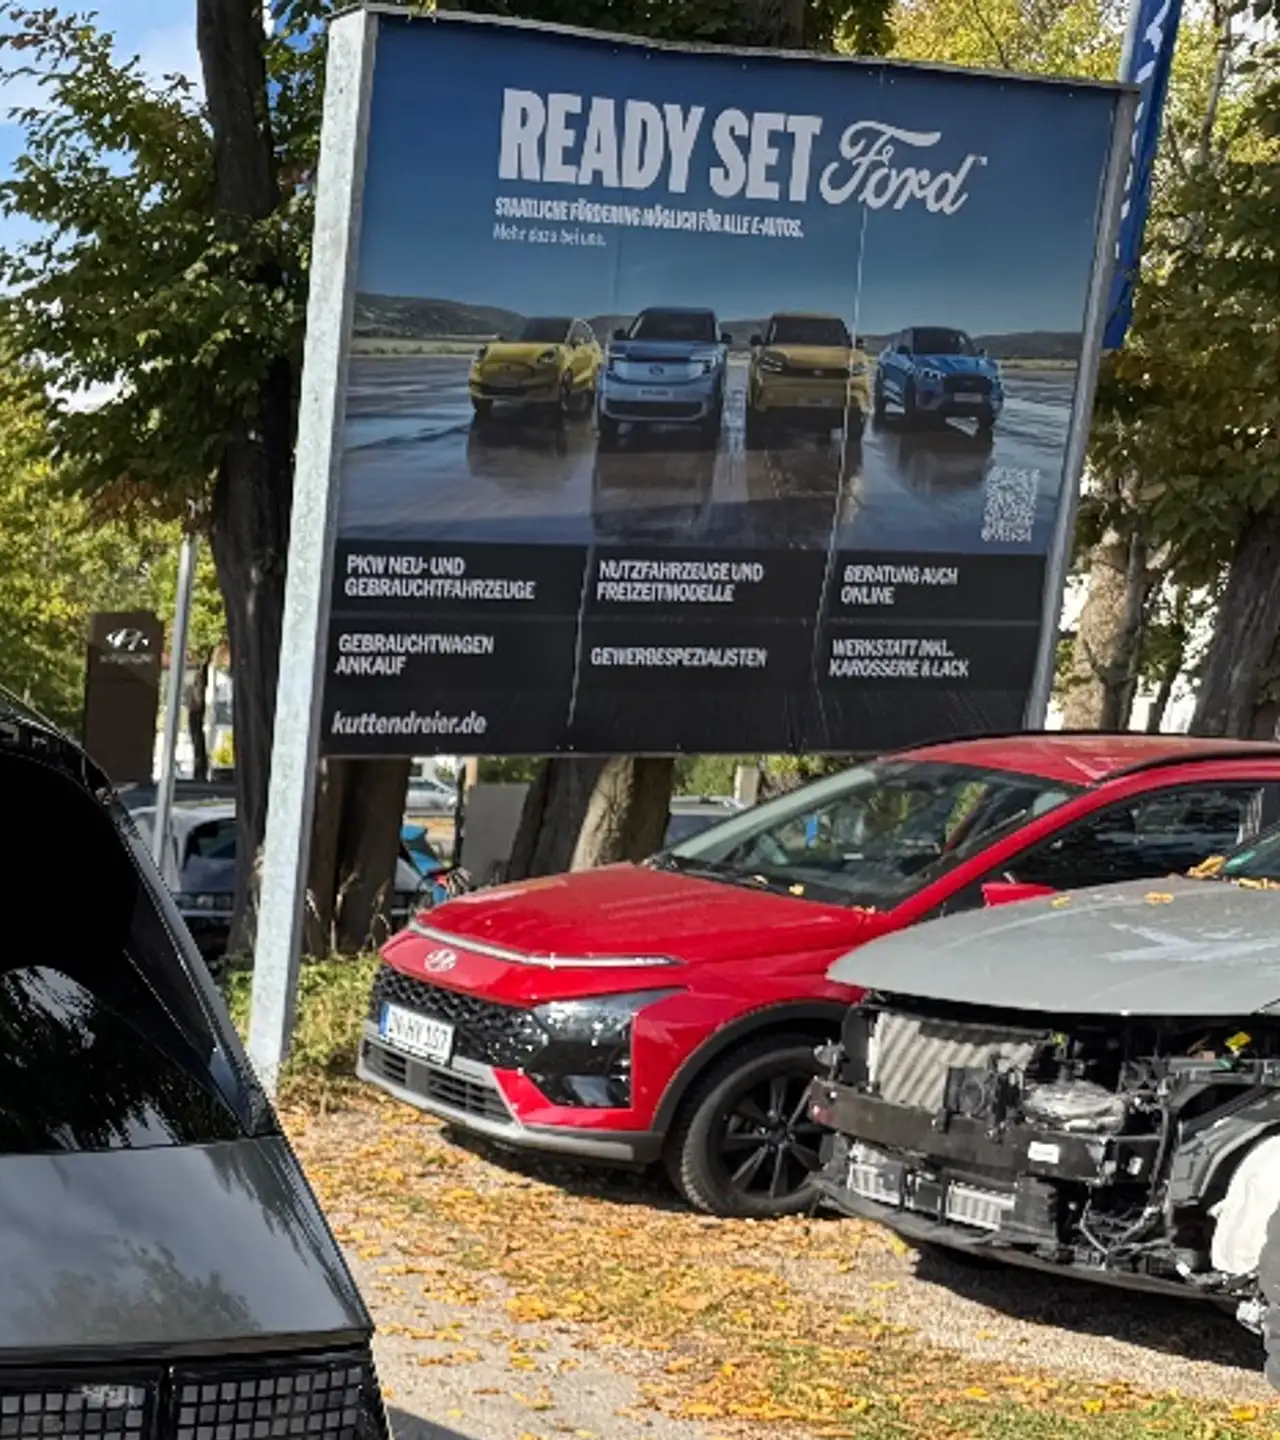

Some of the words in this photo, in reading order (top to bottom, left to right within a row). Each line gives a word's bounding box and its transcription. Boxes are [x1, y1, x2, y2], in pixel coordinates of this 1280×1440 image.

[498, 87, 705, 194] READY
[709, 108, 823, 203] SET
[819, 120, 977, 216] Ford
[494, 196, 569, 222] STAATLICHE
[723, 213, 749, 235] ALLE
[346, 554, 387, 575] PKW
[388, 556, 429, 576] NEU-
[429, 556, 466, 577] UND
[598, 559, 730, 581] NUTZFAHRZEUGE
[731, 562, 765, 583] UND
[843, 564, 919, 584] BERATUNG
[920, 566, 959, 586] AUCH
[344, 576, 536, 600] GEBRAUCHTFAHRZEUGE
[596, 581, 736, 602] FREIZEITMODELLE
[840, 585, 896, 605] ONLINE
[337, 633, 495, 655] GEBRAUCHTWAGEN
[831, 638, 918, 658] WERKSTATT
[333, 655, 407, 676] ANKAUF
[590, 646, 768, 668] GEWERBESPEZIALISTEN
[829, 657, 919, 678] KAROSSERIE
[931, 659, 970, 679] LACK
[331, 709, 488, 734] kuttendreier.de
